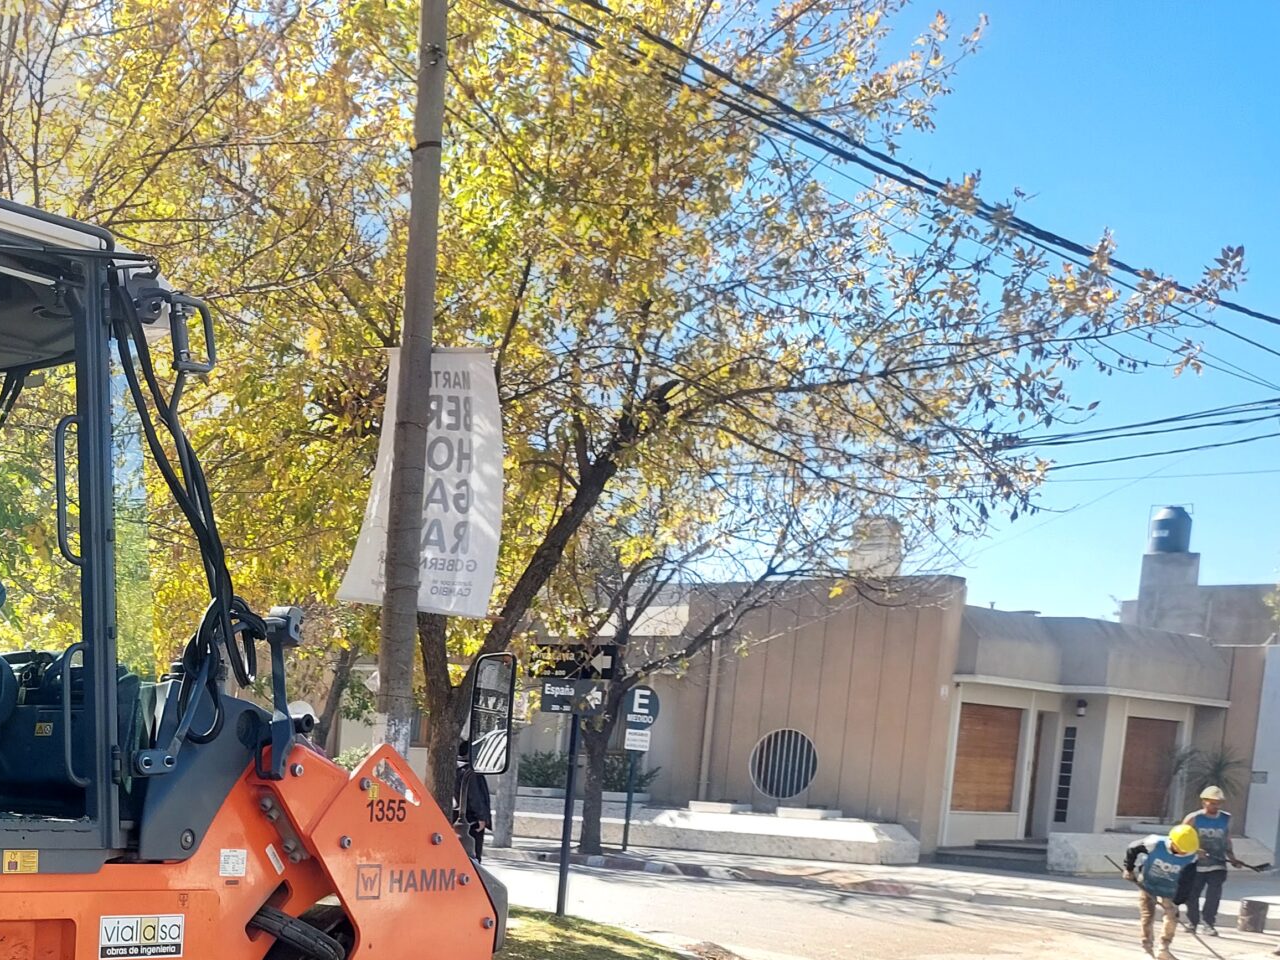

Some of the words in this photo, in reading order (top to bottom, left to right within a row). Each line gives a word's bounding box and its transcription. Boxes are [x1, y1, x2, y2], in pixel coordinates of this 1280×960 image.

[544, 683, 575, 698] España
[633, 689, 651, 714] E
[366, 798, 407, 823] 1355
[389, 868, 456, 893] HAMM
[106, 946, 127, 956] obras
[128, 946, 139, 955] de
